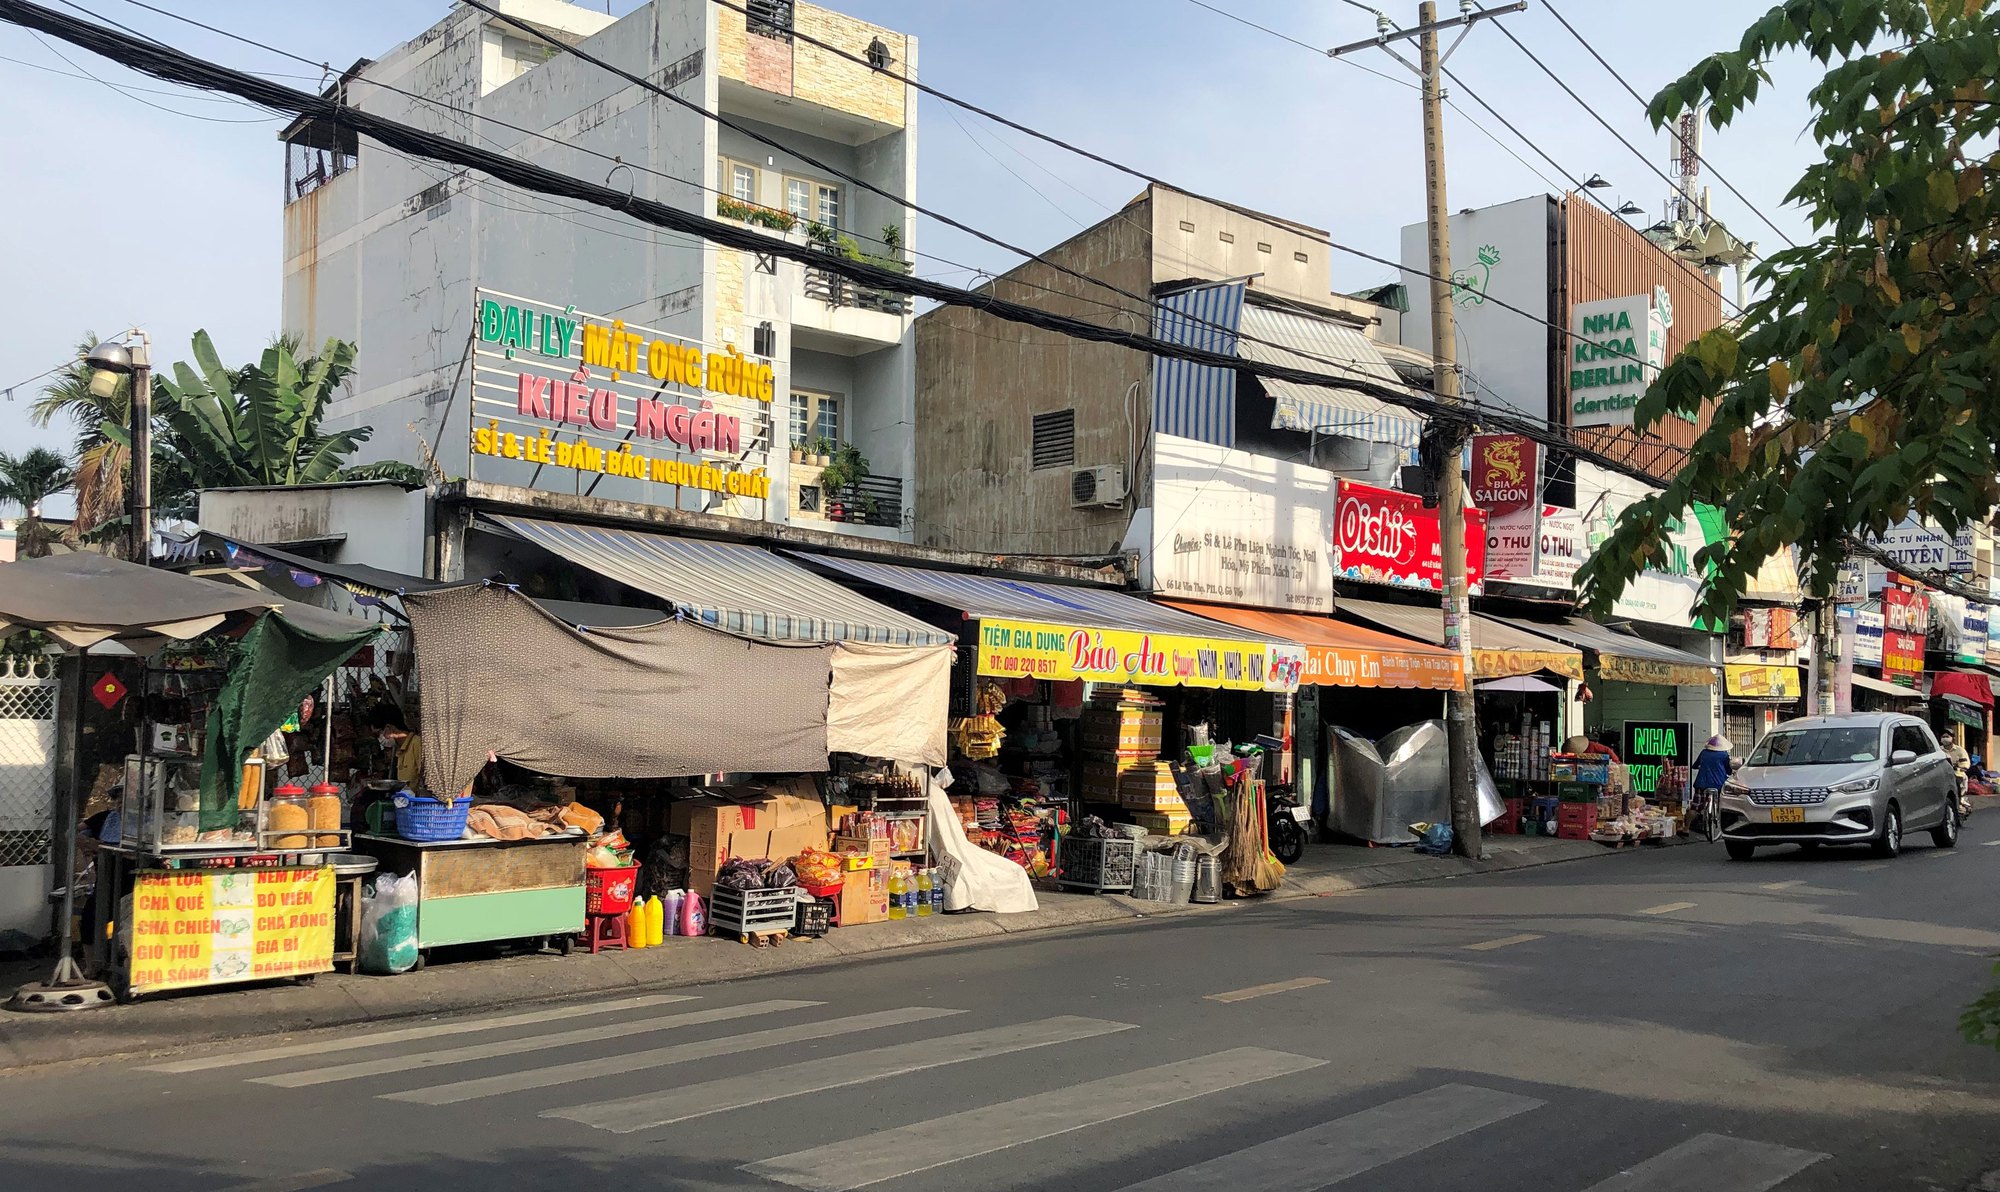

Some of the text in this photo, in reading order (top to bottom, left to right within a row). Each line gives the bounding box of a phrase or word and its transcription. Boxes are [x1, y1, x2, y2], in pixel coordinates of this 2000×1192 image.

[1583, 311, 1632, 335] NHA
[480, 299, 773, 402] ĐẠI LÝ MẬT ONG RỪNG
[1575, 337, 1638, 363] KHOA
[1571, 363, 1645, 391] BERLIN
[518, 365, 740, 454] KIỀU NGÂN
[1574, 393, 1639, 414] dentist
[475, 419, 771, 499] SỈ & LẺ ĐẢM BẢO NGUYÊN CHẤT
[1475, 488, 1528, 501] SAIGON
[1494, 481, 1511, 489] BIA
[1340, 497, 1402, 558] Oishi
[1214, 535, 1220, 548] &
[984, 624, 1065, 655] TIỆM GIA DỤNG
[1068, 629, 1169, 676] Bảo An
[990, 655, 1057, 674] ĐT: 090 220 8517
[1248, 653, 1264, 682] INOX
[1360, 654, 1381, 678] Em
[1634, 728, 1678, 756] NHA
[175, 891, 204, 912] QUẾ
[174, 917, 220, 935] CHIÊN
